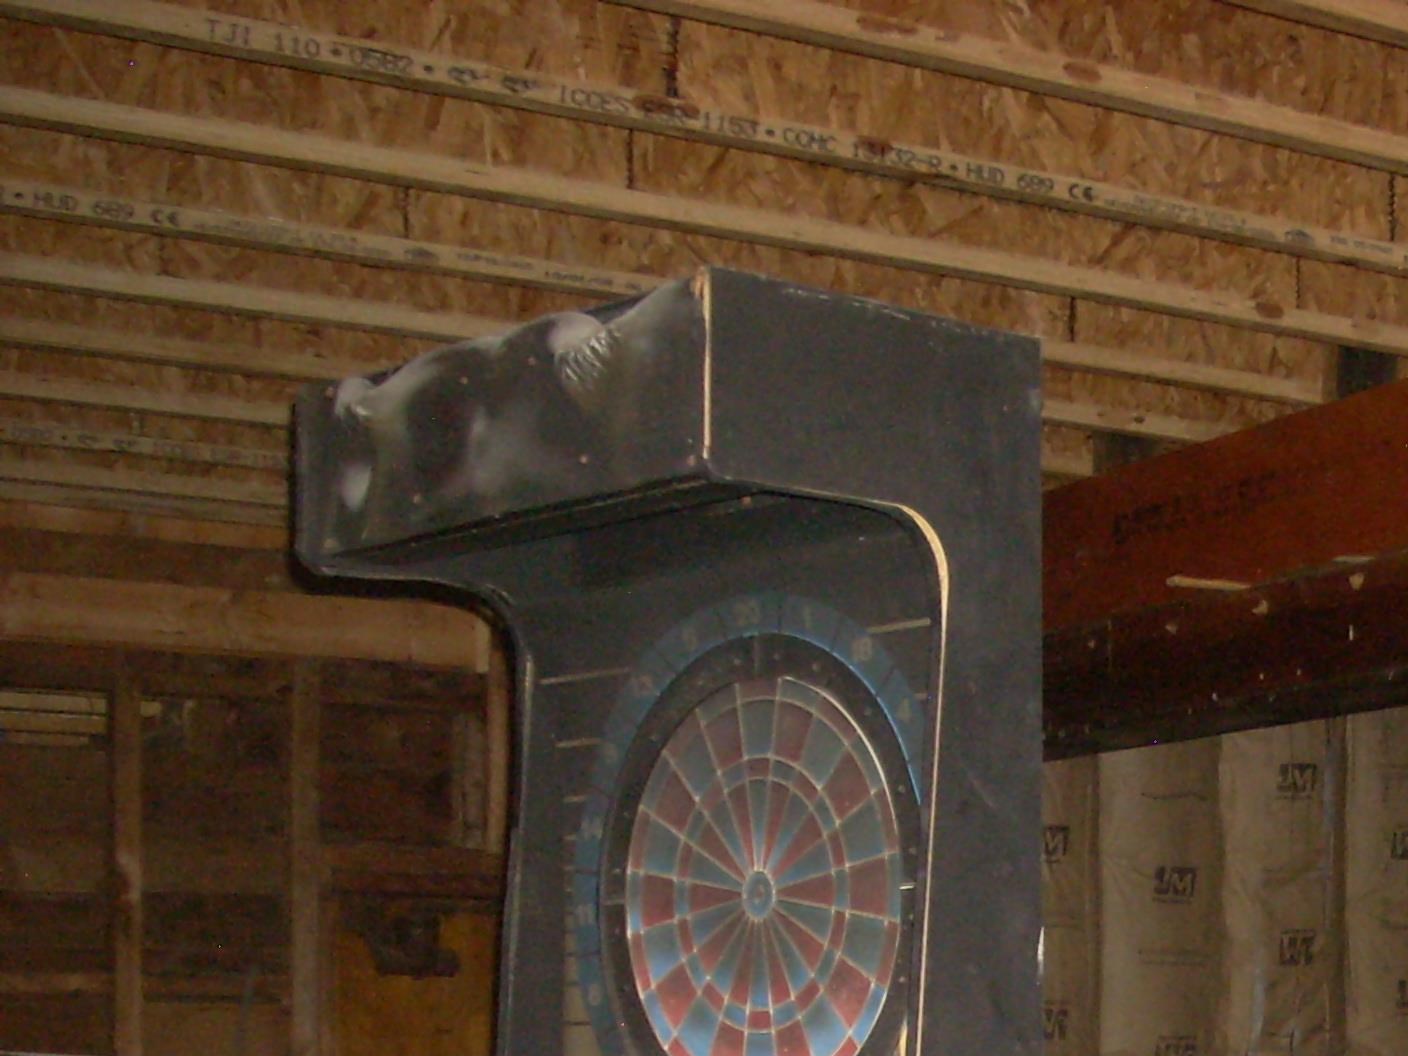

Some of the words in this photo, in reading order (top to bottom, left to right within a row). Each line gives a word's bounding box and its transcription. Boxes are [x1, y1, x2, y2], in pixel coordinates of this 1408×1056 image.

[273, 33, 320, 59] 110
[966, 161, 1004, 185] HUD
[1017, 172, 1054, 193] 689
[1154, 866, 1196, 898] JM
